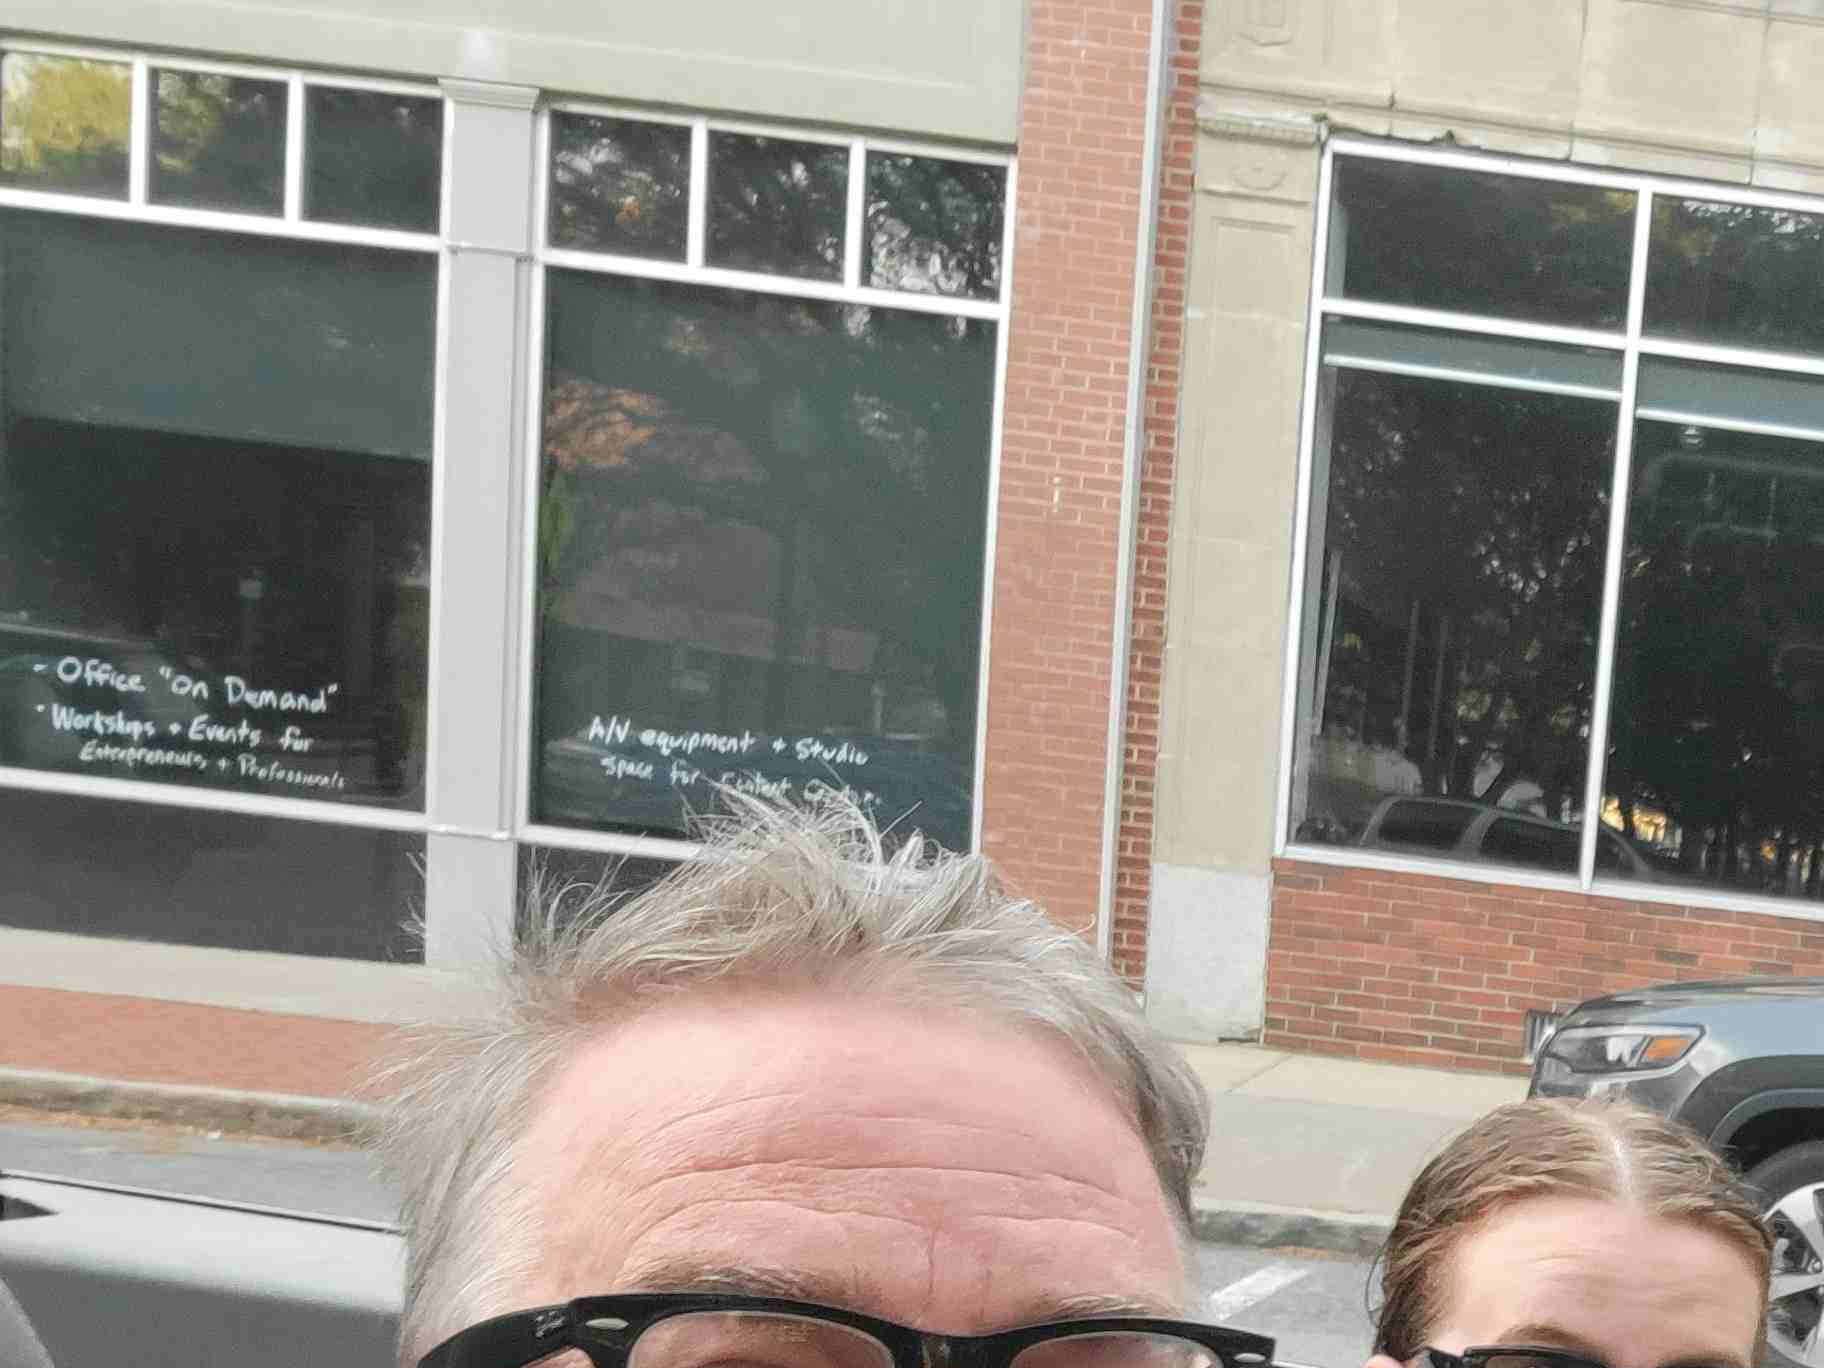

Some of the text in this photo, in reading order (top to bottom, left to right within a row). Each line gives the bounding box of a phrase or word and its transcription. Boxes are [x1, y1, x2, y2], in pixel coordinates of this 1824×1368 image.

[57, 656, 146, 691] Office
[188, 714, 262, 747] Events
[280, 725, 314, 751] for
[669, 759, 701, 785] for
